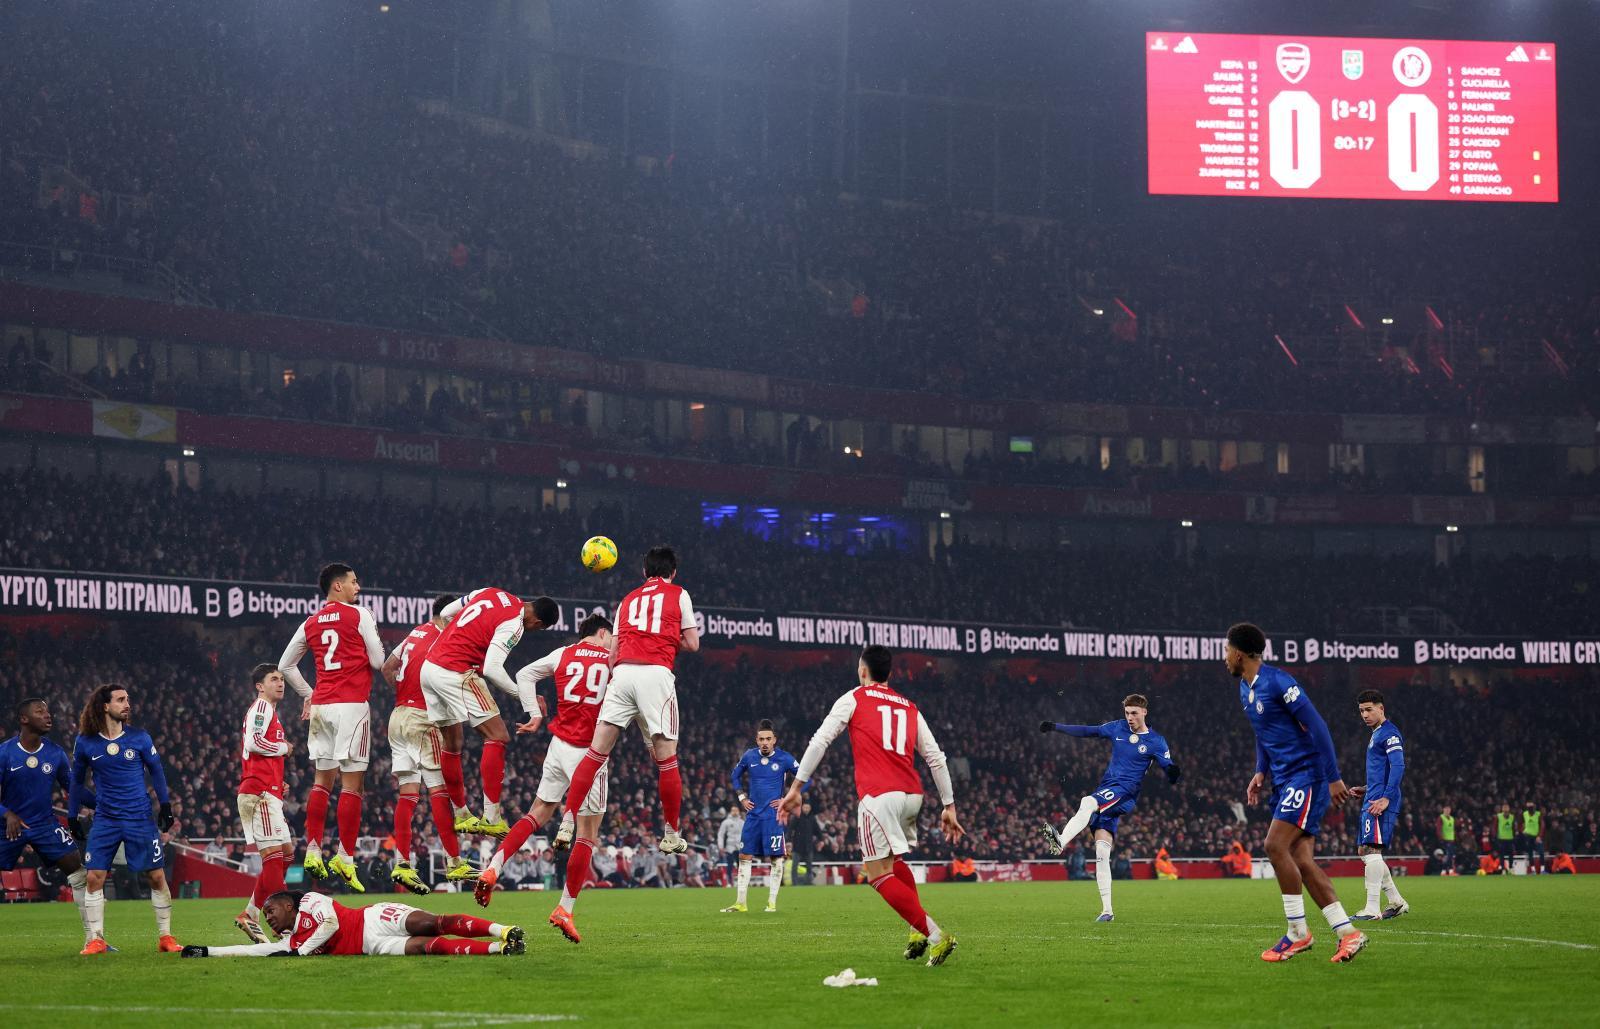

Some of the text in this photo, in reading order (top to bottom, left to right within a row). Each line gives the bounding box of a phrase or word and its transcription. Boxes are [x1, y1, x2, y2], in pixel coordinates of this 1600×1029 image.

[1250, 72, 1258, 82] 2
[1461, 79, 1510, 88] CUCURELLA
[1462, 91, 1511, 100] FERNANDEZ
[1448, 102, 1495, 111] 10 PALMER
[1486, 115, 1514, 124] PEDRO
[1268, 90, 1322, 189] 0
[1334, 135, 1375, 150] 80:17
[1387, 93, 1441, 191] 0
[1462, 138, 1500, 147] CAICEDO
[1449, 150, 1492, 159] 27 GUSTO
[1449, 162, 1498, 171] 29 FOFANA
[1464, 186, 1512, 195] GARNACHO
[374, 434, 439, 464] Arsenal
[0, 576, 198, 614] YPTO, THEN BITPANDA.
[318, 612, 340, 623] SALIBA
[457, 600, 494, 627] 6
[628, 593, 664, 633] 41
[708, 615, 772, 639] bitpanda
[777, 617, 961, 650] WHEN CRYPTO, THEN BITPANDA.
[321, 629, 342, 671] 2
[994, 632, 1058, 653] bitpanda
[1064, 633, 1104, 656] WHEN
[1108, 634, 1163, 661] CRYPTO,
[1164, 637, 1197, 659] THEN
[1323, 641, 1398, 662] bitpanda
[575, 649, 610, 659] HAVERTZ
[1433, 643, 1515, 663] bitpanda
[1523, 642, 1570, 663] WHEN
[564, 661, 610, 705] 29
[865, 690, 910, 708] MARTINELLI
[877, 705, 908, 755] 11
[1100, 789, 1114, 801] 10
[1281, 787, 1305, 809] 29
[1365, 819, 1371, 833] 8
[152, 839, 161, 857] 3
[770, 835, 783, 849] 27
